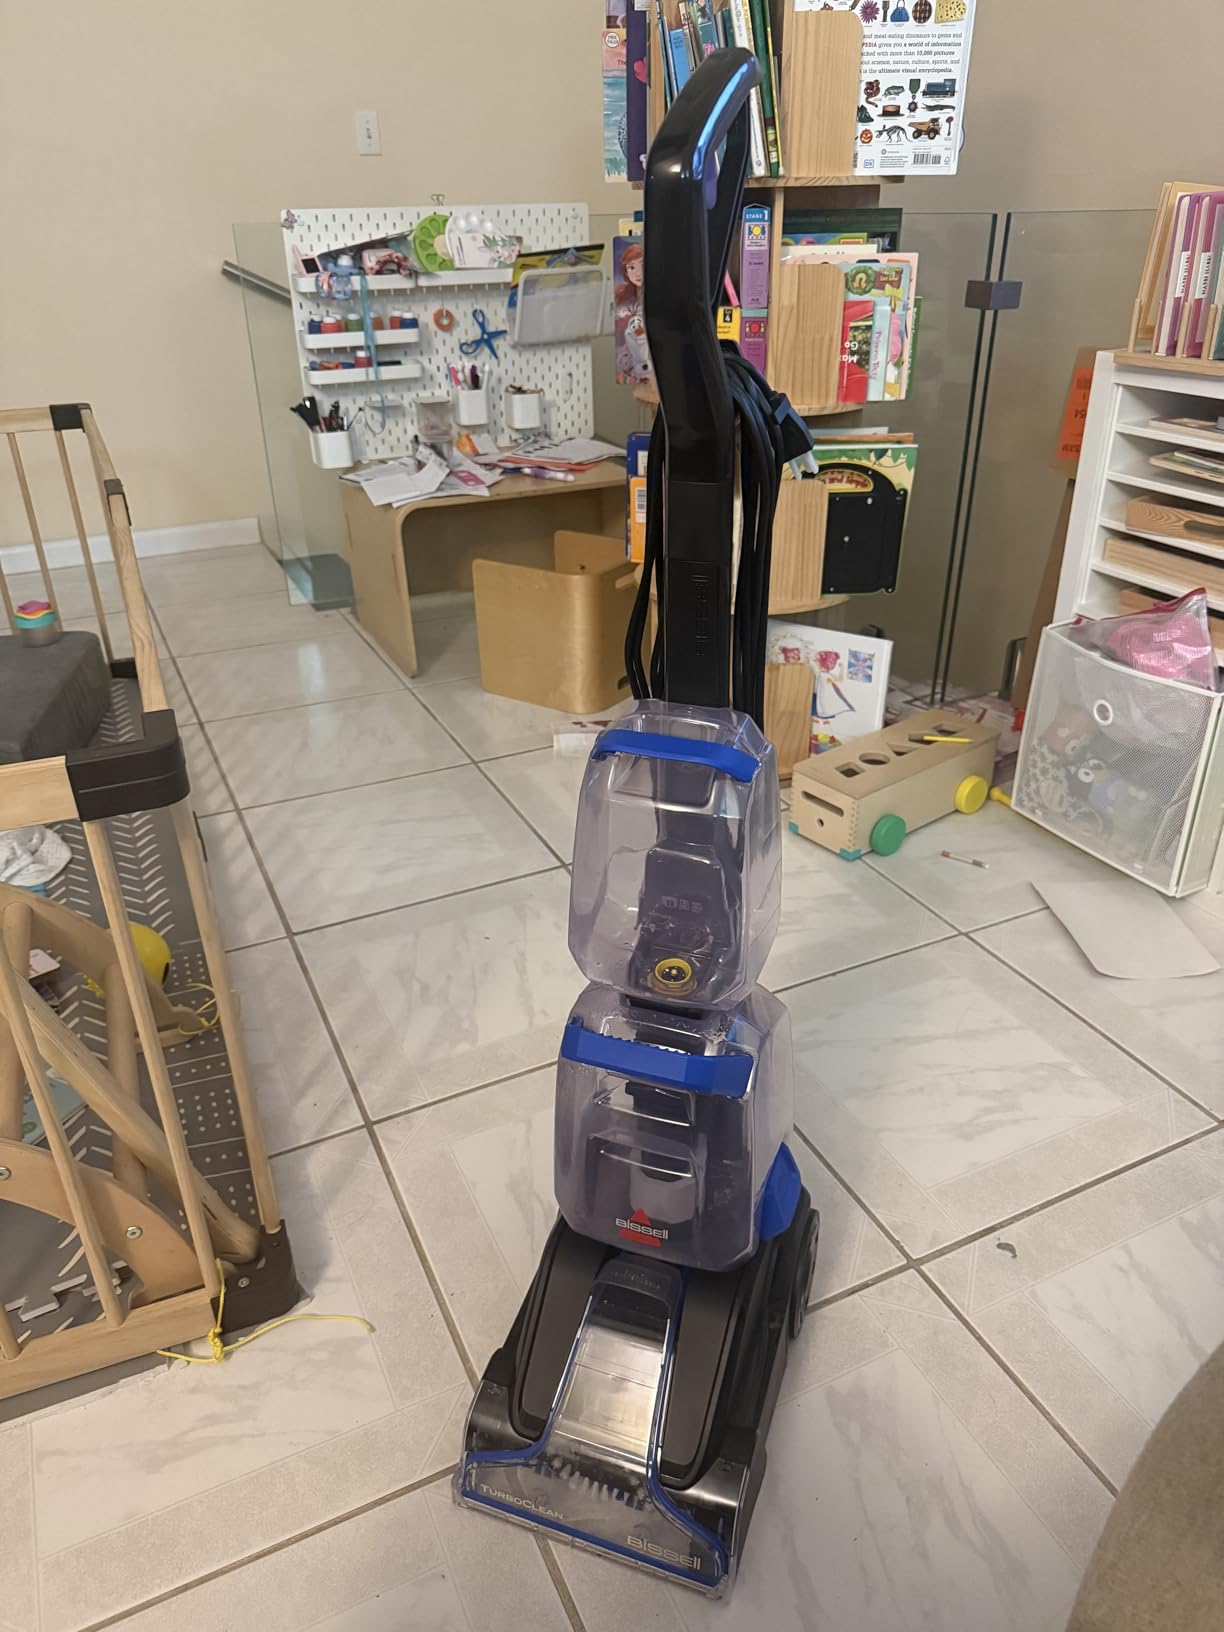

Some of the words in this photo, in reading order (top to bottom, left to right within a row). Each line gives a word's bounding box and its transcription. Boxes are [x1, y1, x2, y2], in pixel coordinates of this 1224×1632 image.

[764, 210, 768, 220] 1
[844, 341, 858, 350] Go
[616, 1218, 668, 1240] BISSELL
[480, 1484, 563, 1520] TURBOCLEAN
[627, 1536, 700, 1570] BISSELL
